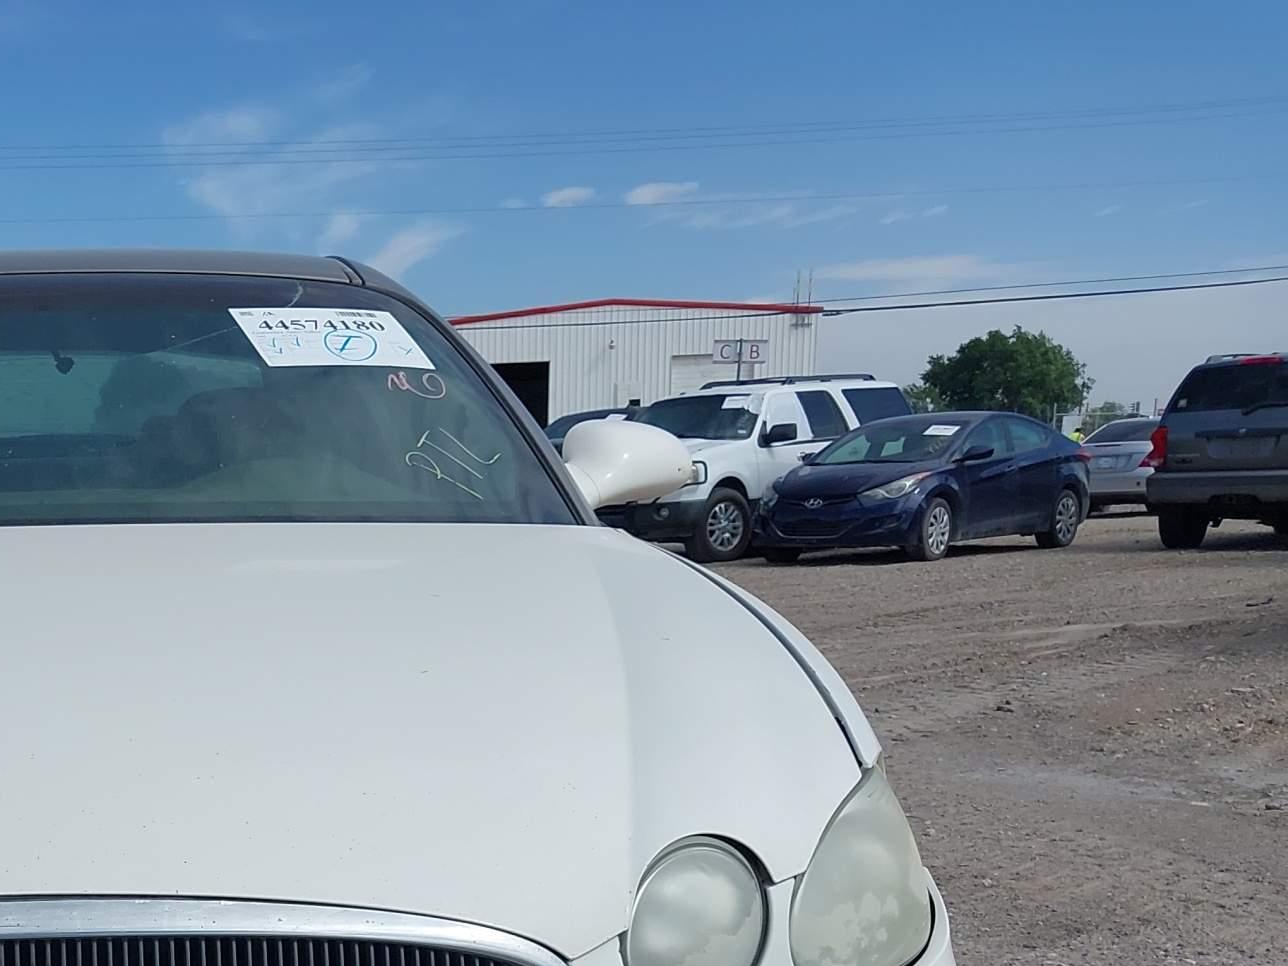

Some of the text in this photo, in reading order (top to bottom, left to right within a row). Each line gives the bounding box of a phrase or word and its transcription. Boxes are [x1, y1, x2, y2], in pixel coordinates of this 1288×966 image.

[258, 319, 386, 332] 44574180
[719, 344, 761, 360] C B
